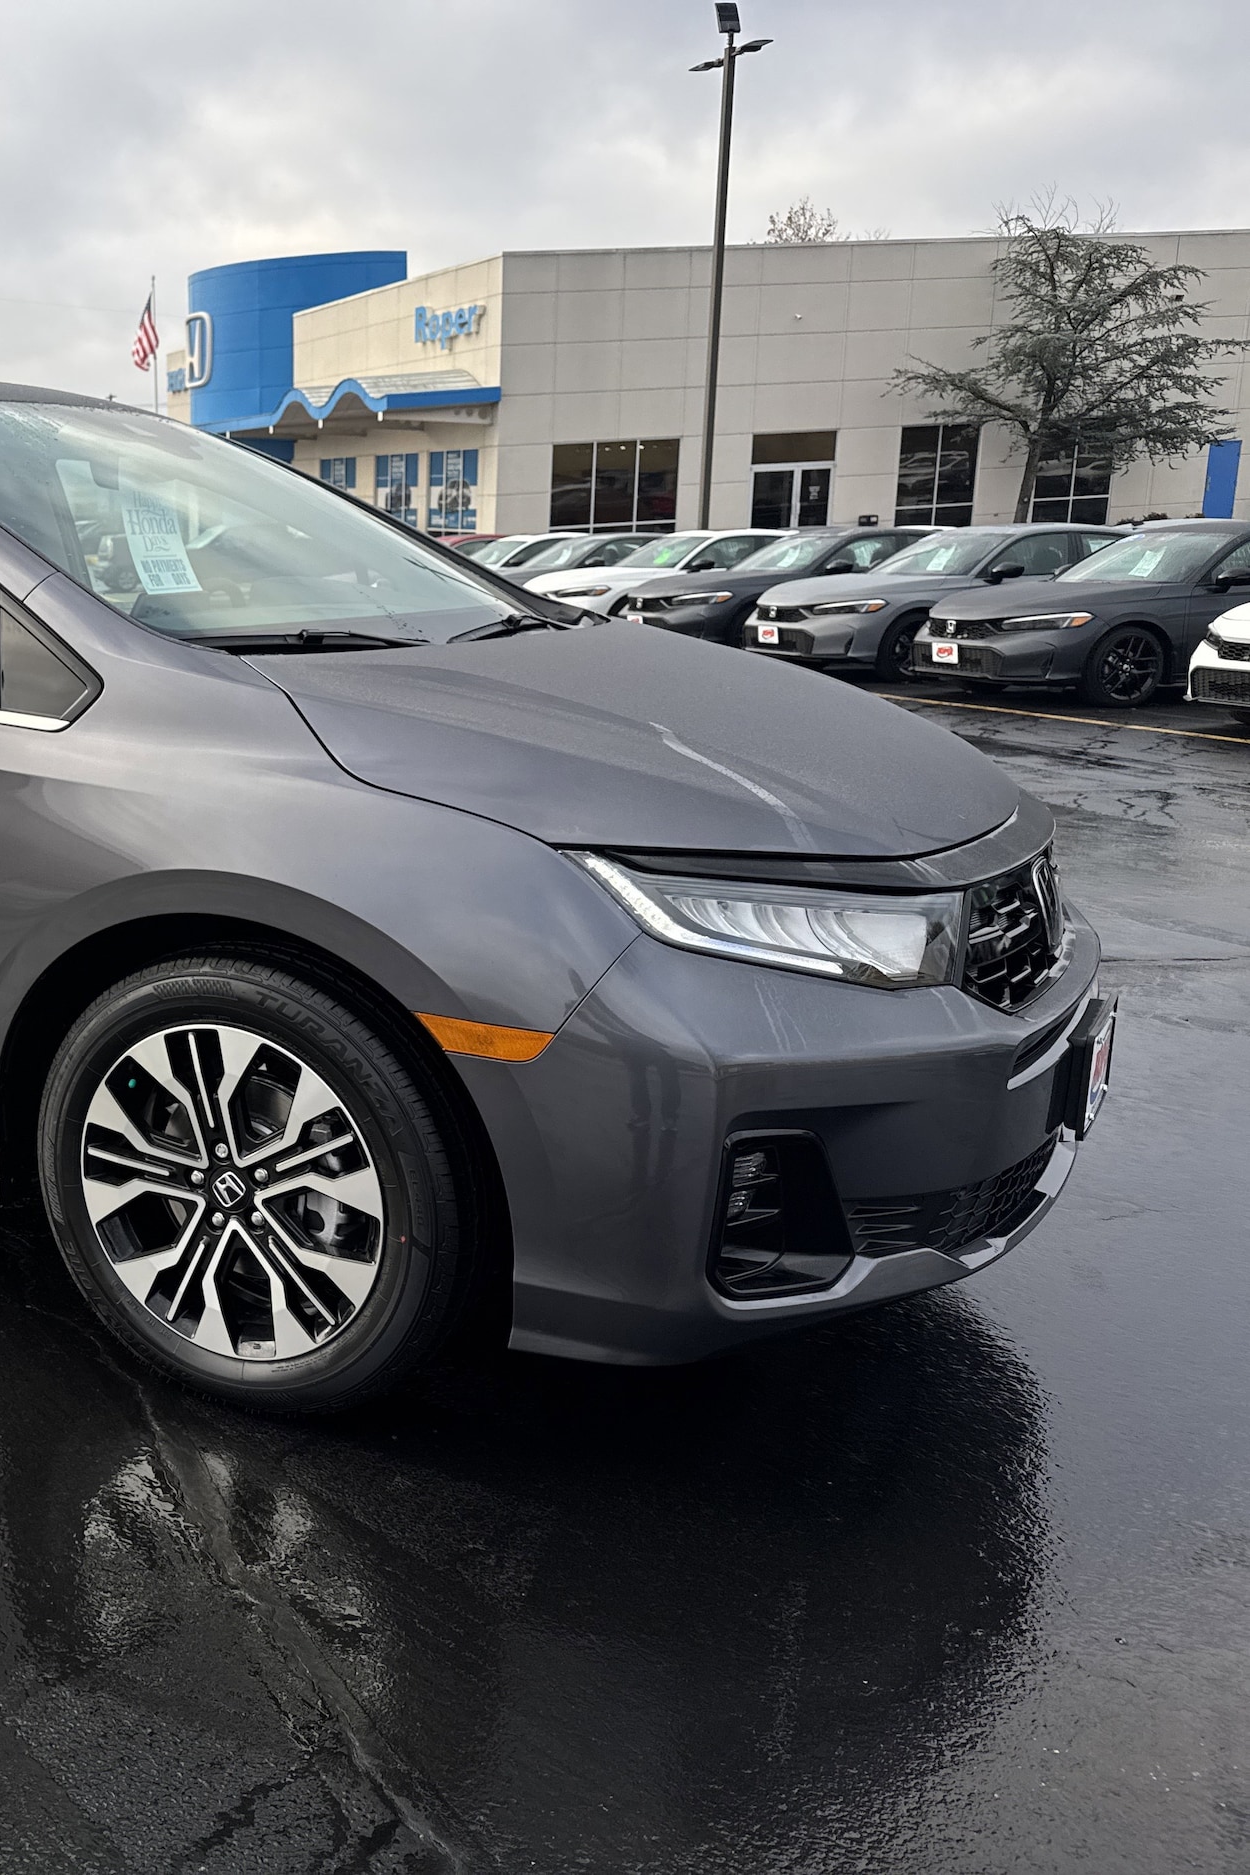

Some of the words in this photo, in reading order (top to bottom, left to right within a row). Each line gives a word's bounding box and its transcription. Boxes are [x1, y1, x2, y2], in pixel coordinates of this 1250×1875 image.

[414, 305, 482, 351] Roper
[126, 509, 177, 535] Honda
[253, 990, 404, 1136] TURANZA
